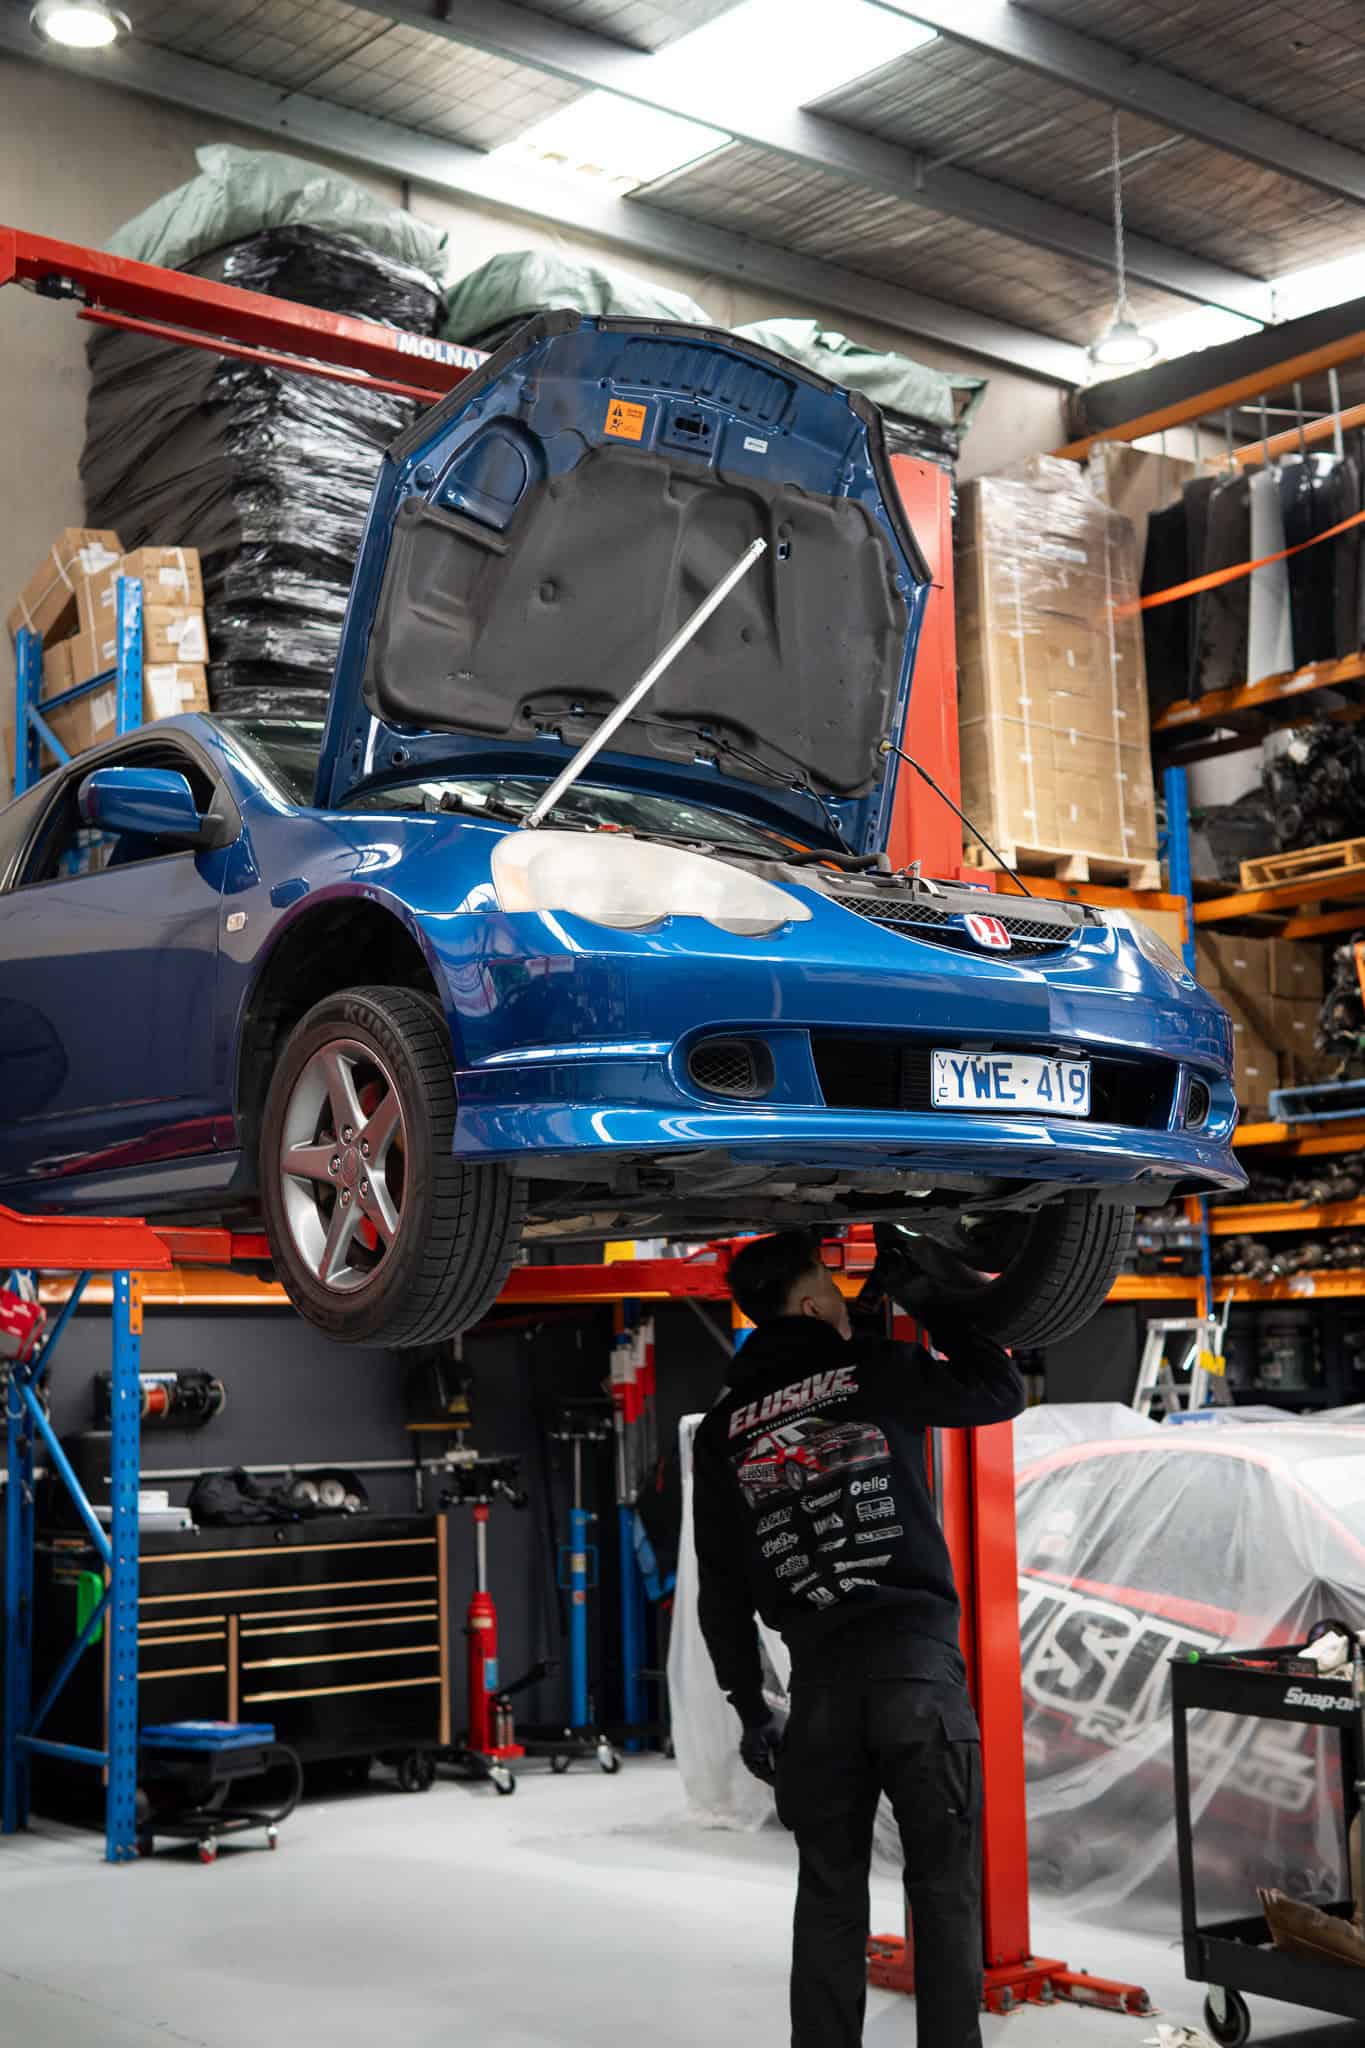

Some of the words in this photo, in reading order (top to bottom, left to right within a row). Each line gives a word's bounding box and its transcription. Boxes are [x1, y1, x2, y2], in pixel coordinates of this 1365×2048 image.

[950, 1060, 1016, 1099] YWE
[1037, 1065, 1086, 1105] 419
[728, 1365, 858, 1439] ELUSIVE
